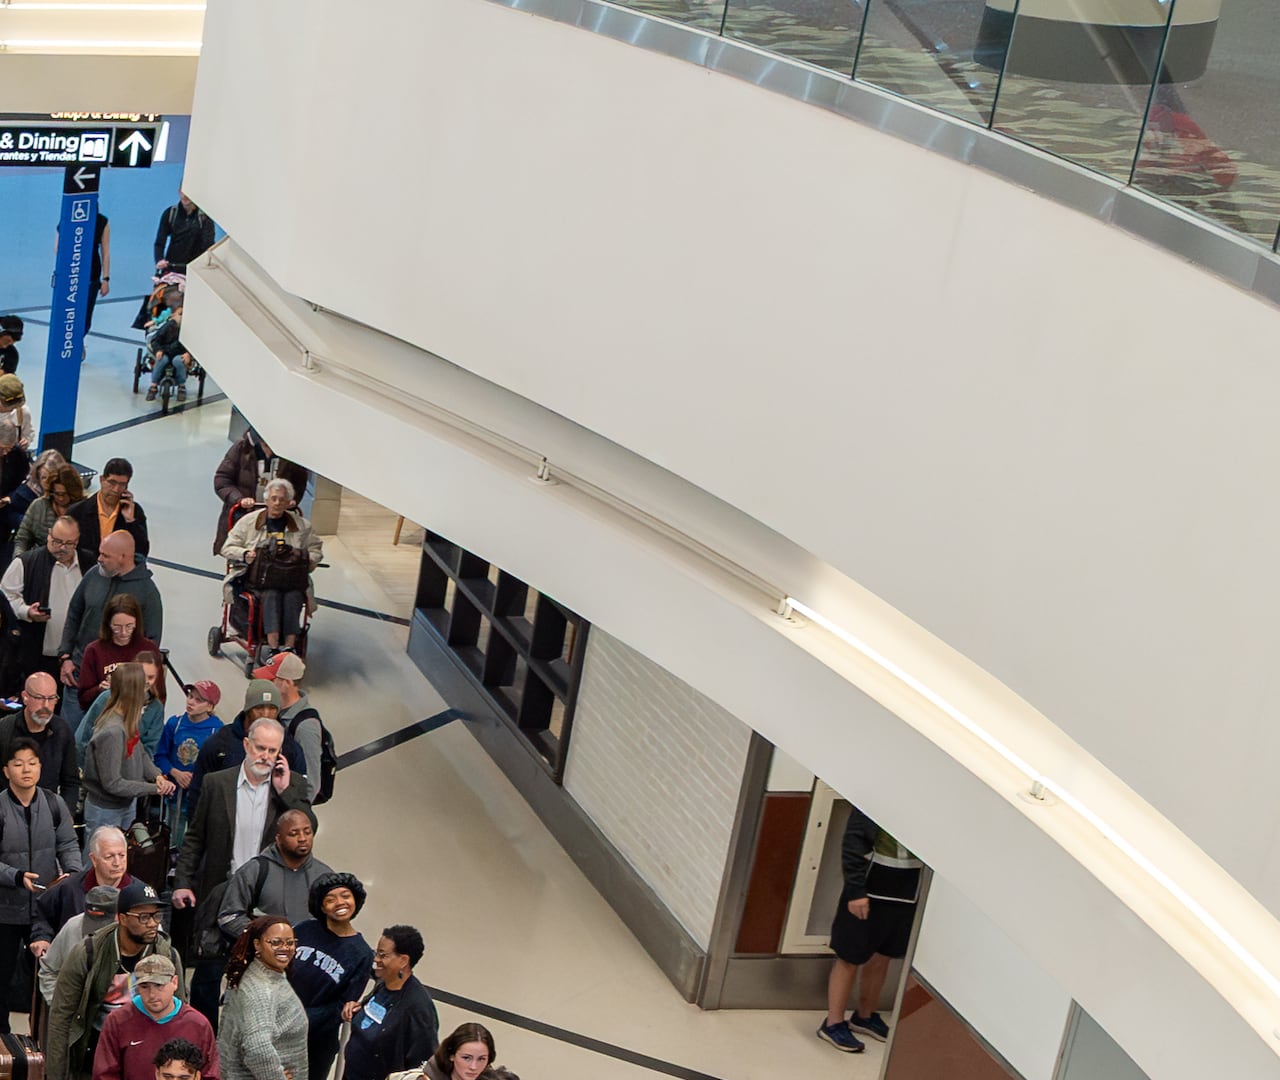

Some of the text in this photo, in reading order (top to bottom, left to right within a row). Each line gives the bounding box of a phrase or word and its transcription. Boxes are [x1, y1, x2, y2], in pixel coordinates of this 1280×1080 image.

[18, 133, 81, 152] Dining
[30, 152, 38, 162] y
[40, 151, 76, 162] Tiendas
[61, 226, 84, 359] Special Assistance
